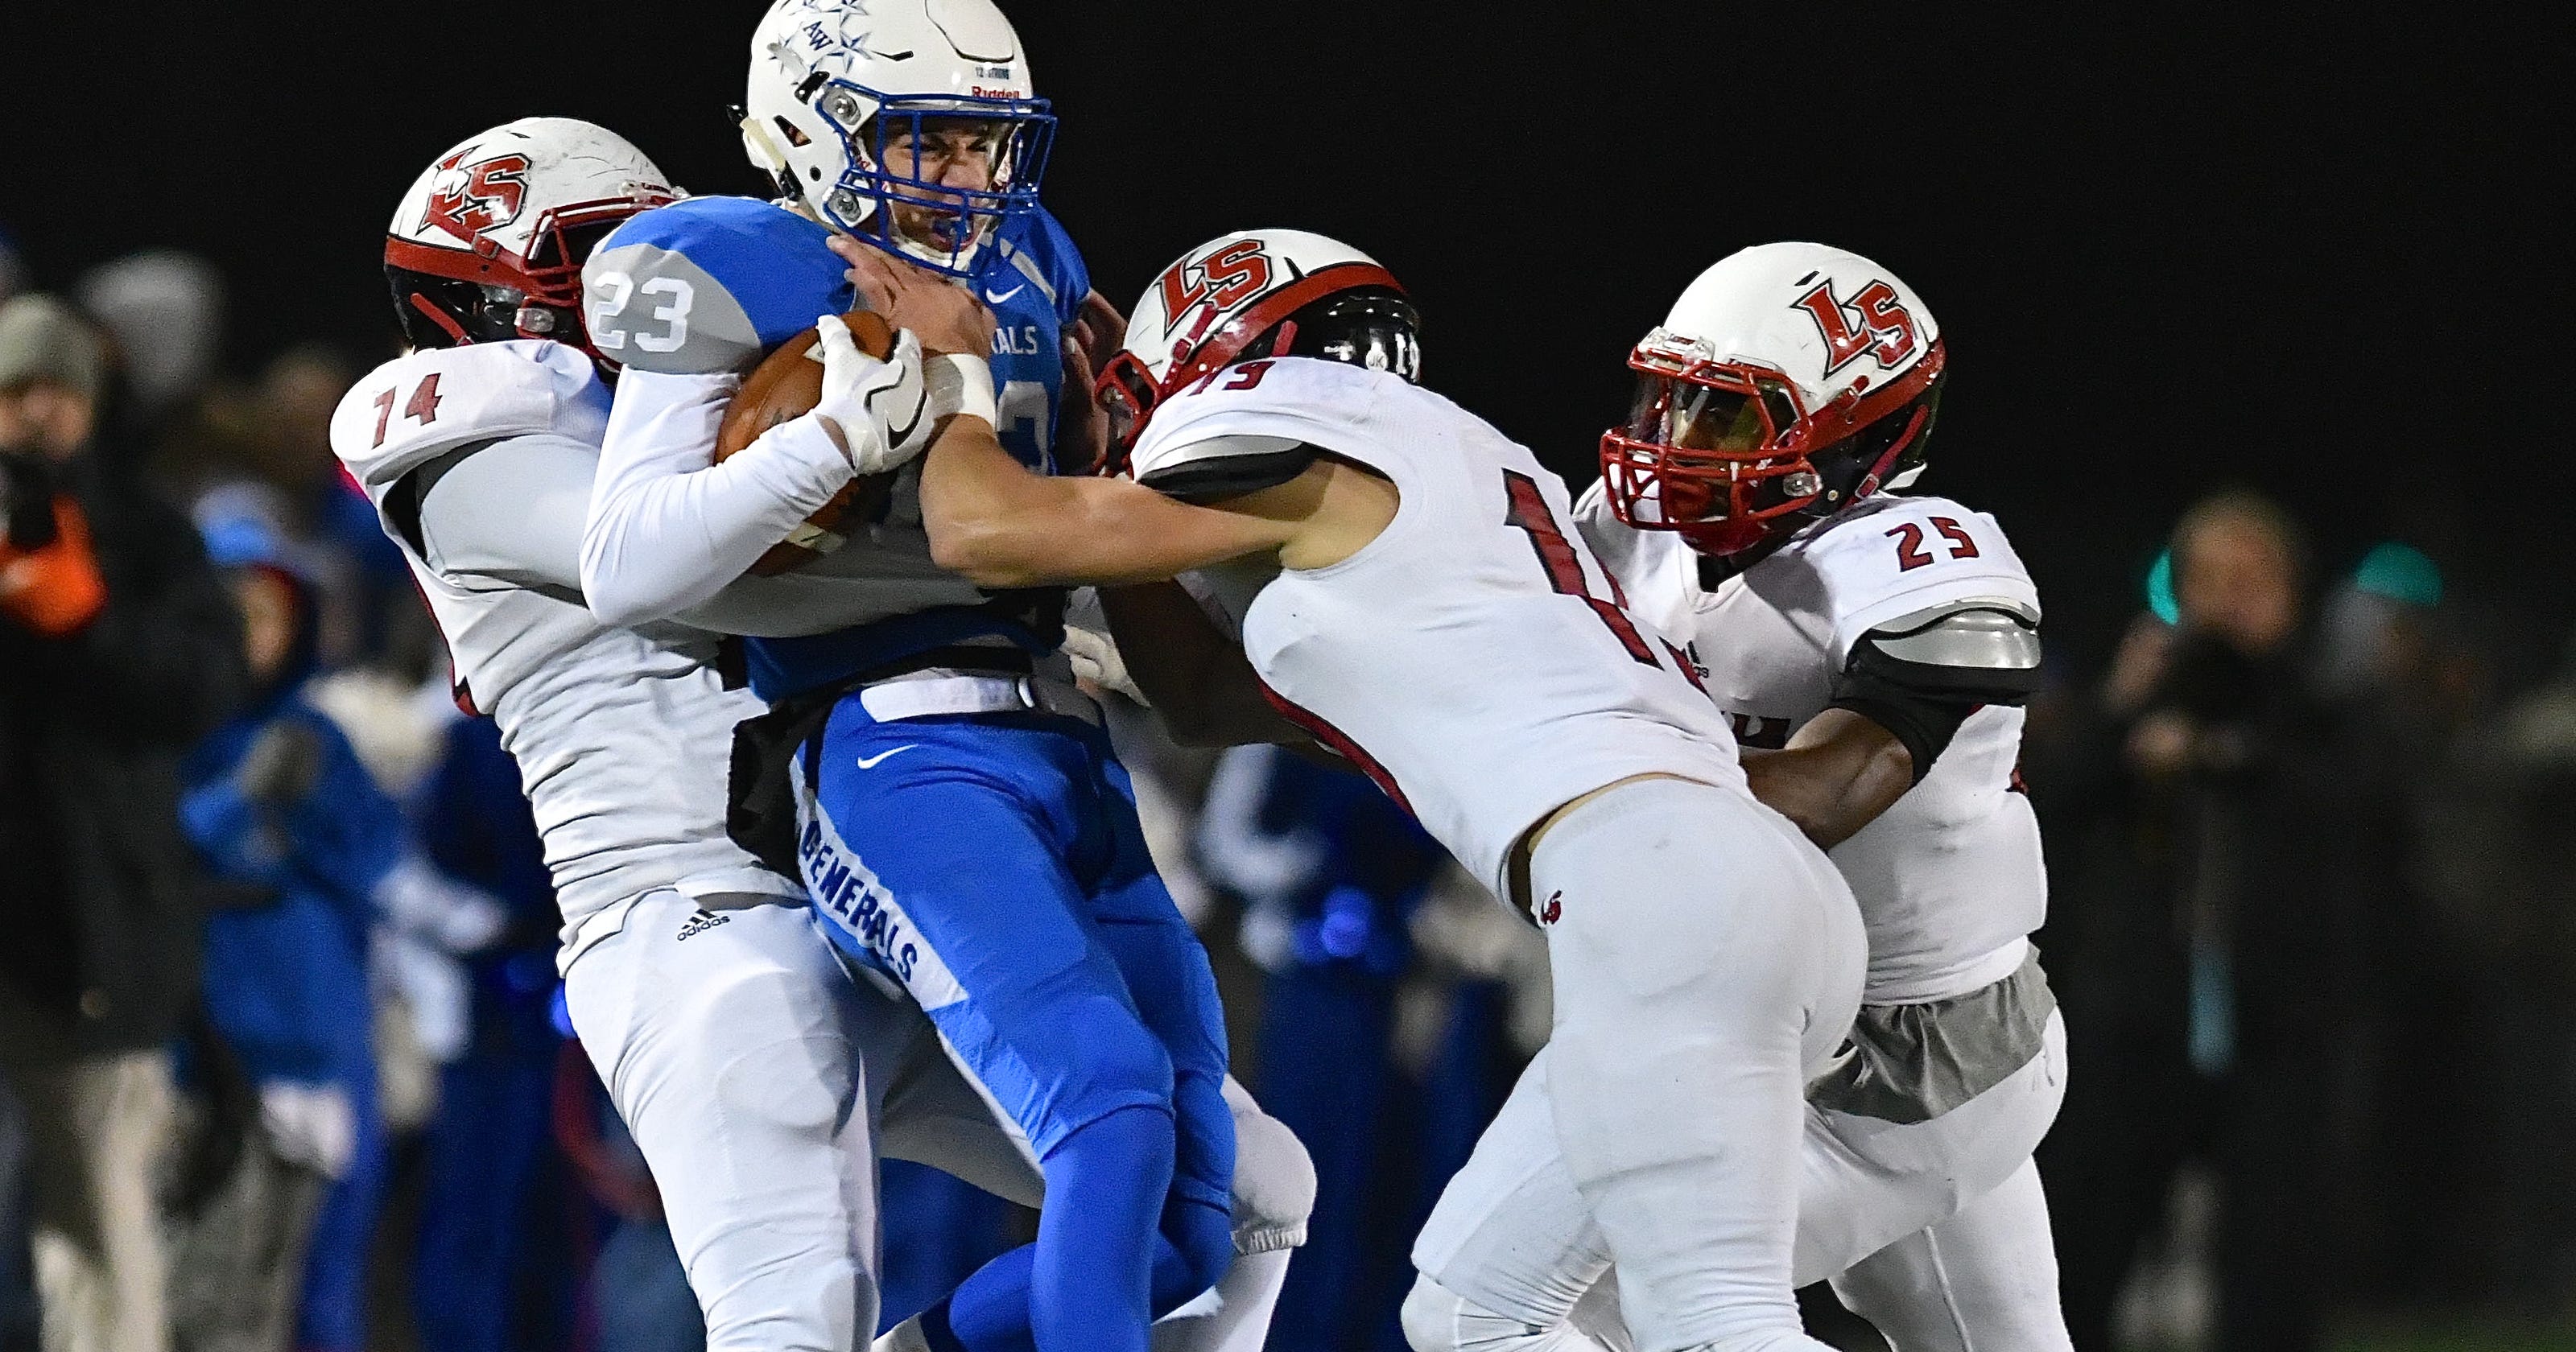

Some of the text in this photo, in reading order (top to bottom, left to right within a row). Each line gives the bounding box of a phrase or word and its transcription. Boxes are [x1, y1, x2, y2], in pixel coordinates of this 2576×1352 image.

[803, 21, 834, 51] AW
[417, 145, 535, 235] LS
[591, 271, 694, 353] 23
[1155, 239, 1273, 340] LS
[1790, 278, 1917, 379] LS
[372, 373, 442, 449] 74
[1885, 517, 1979, 571] 25
[677, 916, 730, 941] adidas
[801, 820, 918, 982] GENERALS
